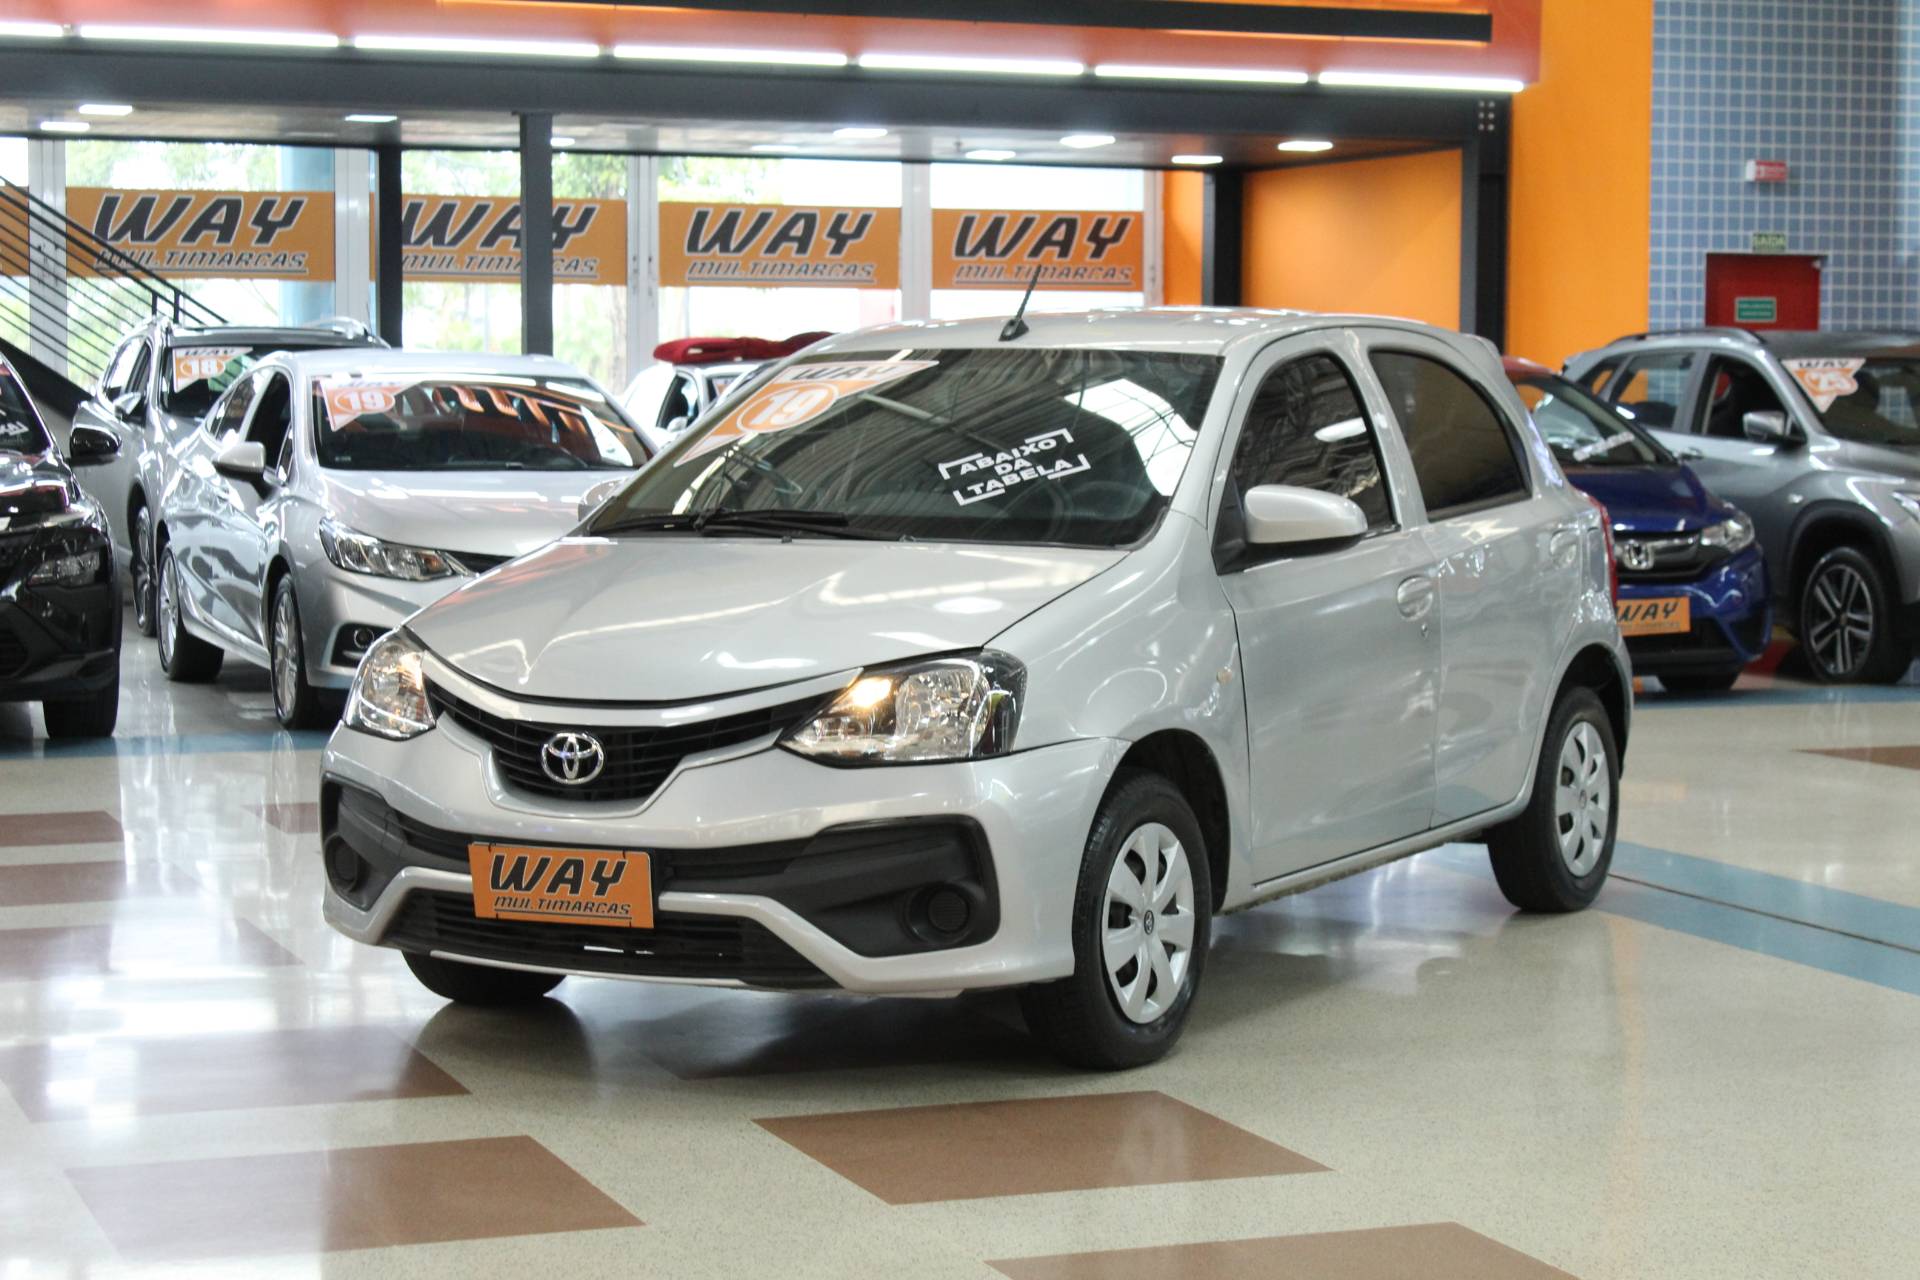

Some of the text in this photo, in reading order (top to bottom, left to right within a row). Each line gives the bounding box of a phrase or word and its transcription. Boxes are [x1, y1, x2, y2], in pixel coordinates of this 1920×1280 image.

[93, 194, 308, 246] WAY
[401, 200, 599, 250] WAY
[685, 208, 875, 257] WAY
[953, 214, 1134, 261] WAY
[686, 261, 876, 278] MULTIMARCAS
[955, 263, 1133, 280] MULTIMARCAS
[188, 359, 217, 377] 18
[348, 391, 385, 411] 19
[749, 388, 830, 426] 19
[960, 438, 1057, 475] ABAIXO
[994, 458, 1032, 476] DA
[967, 459, 1073, 495] TABELA
[1615, 602, 1680, 622] WAY
[490, 853, 628, 897] WAY
[494, 896, 632, 915] MULTIMARCAS
